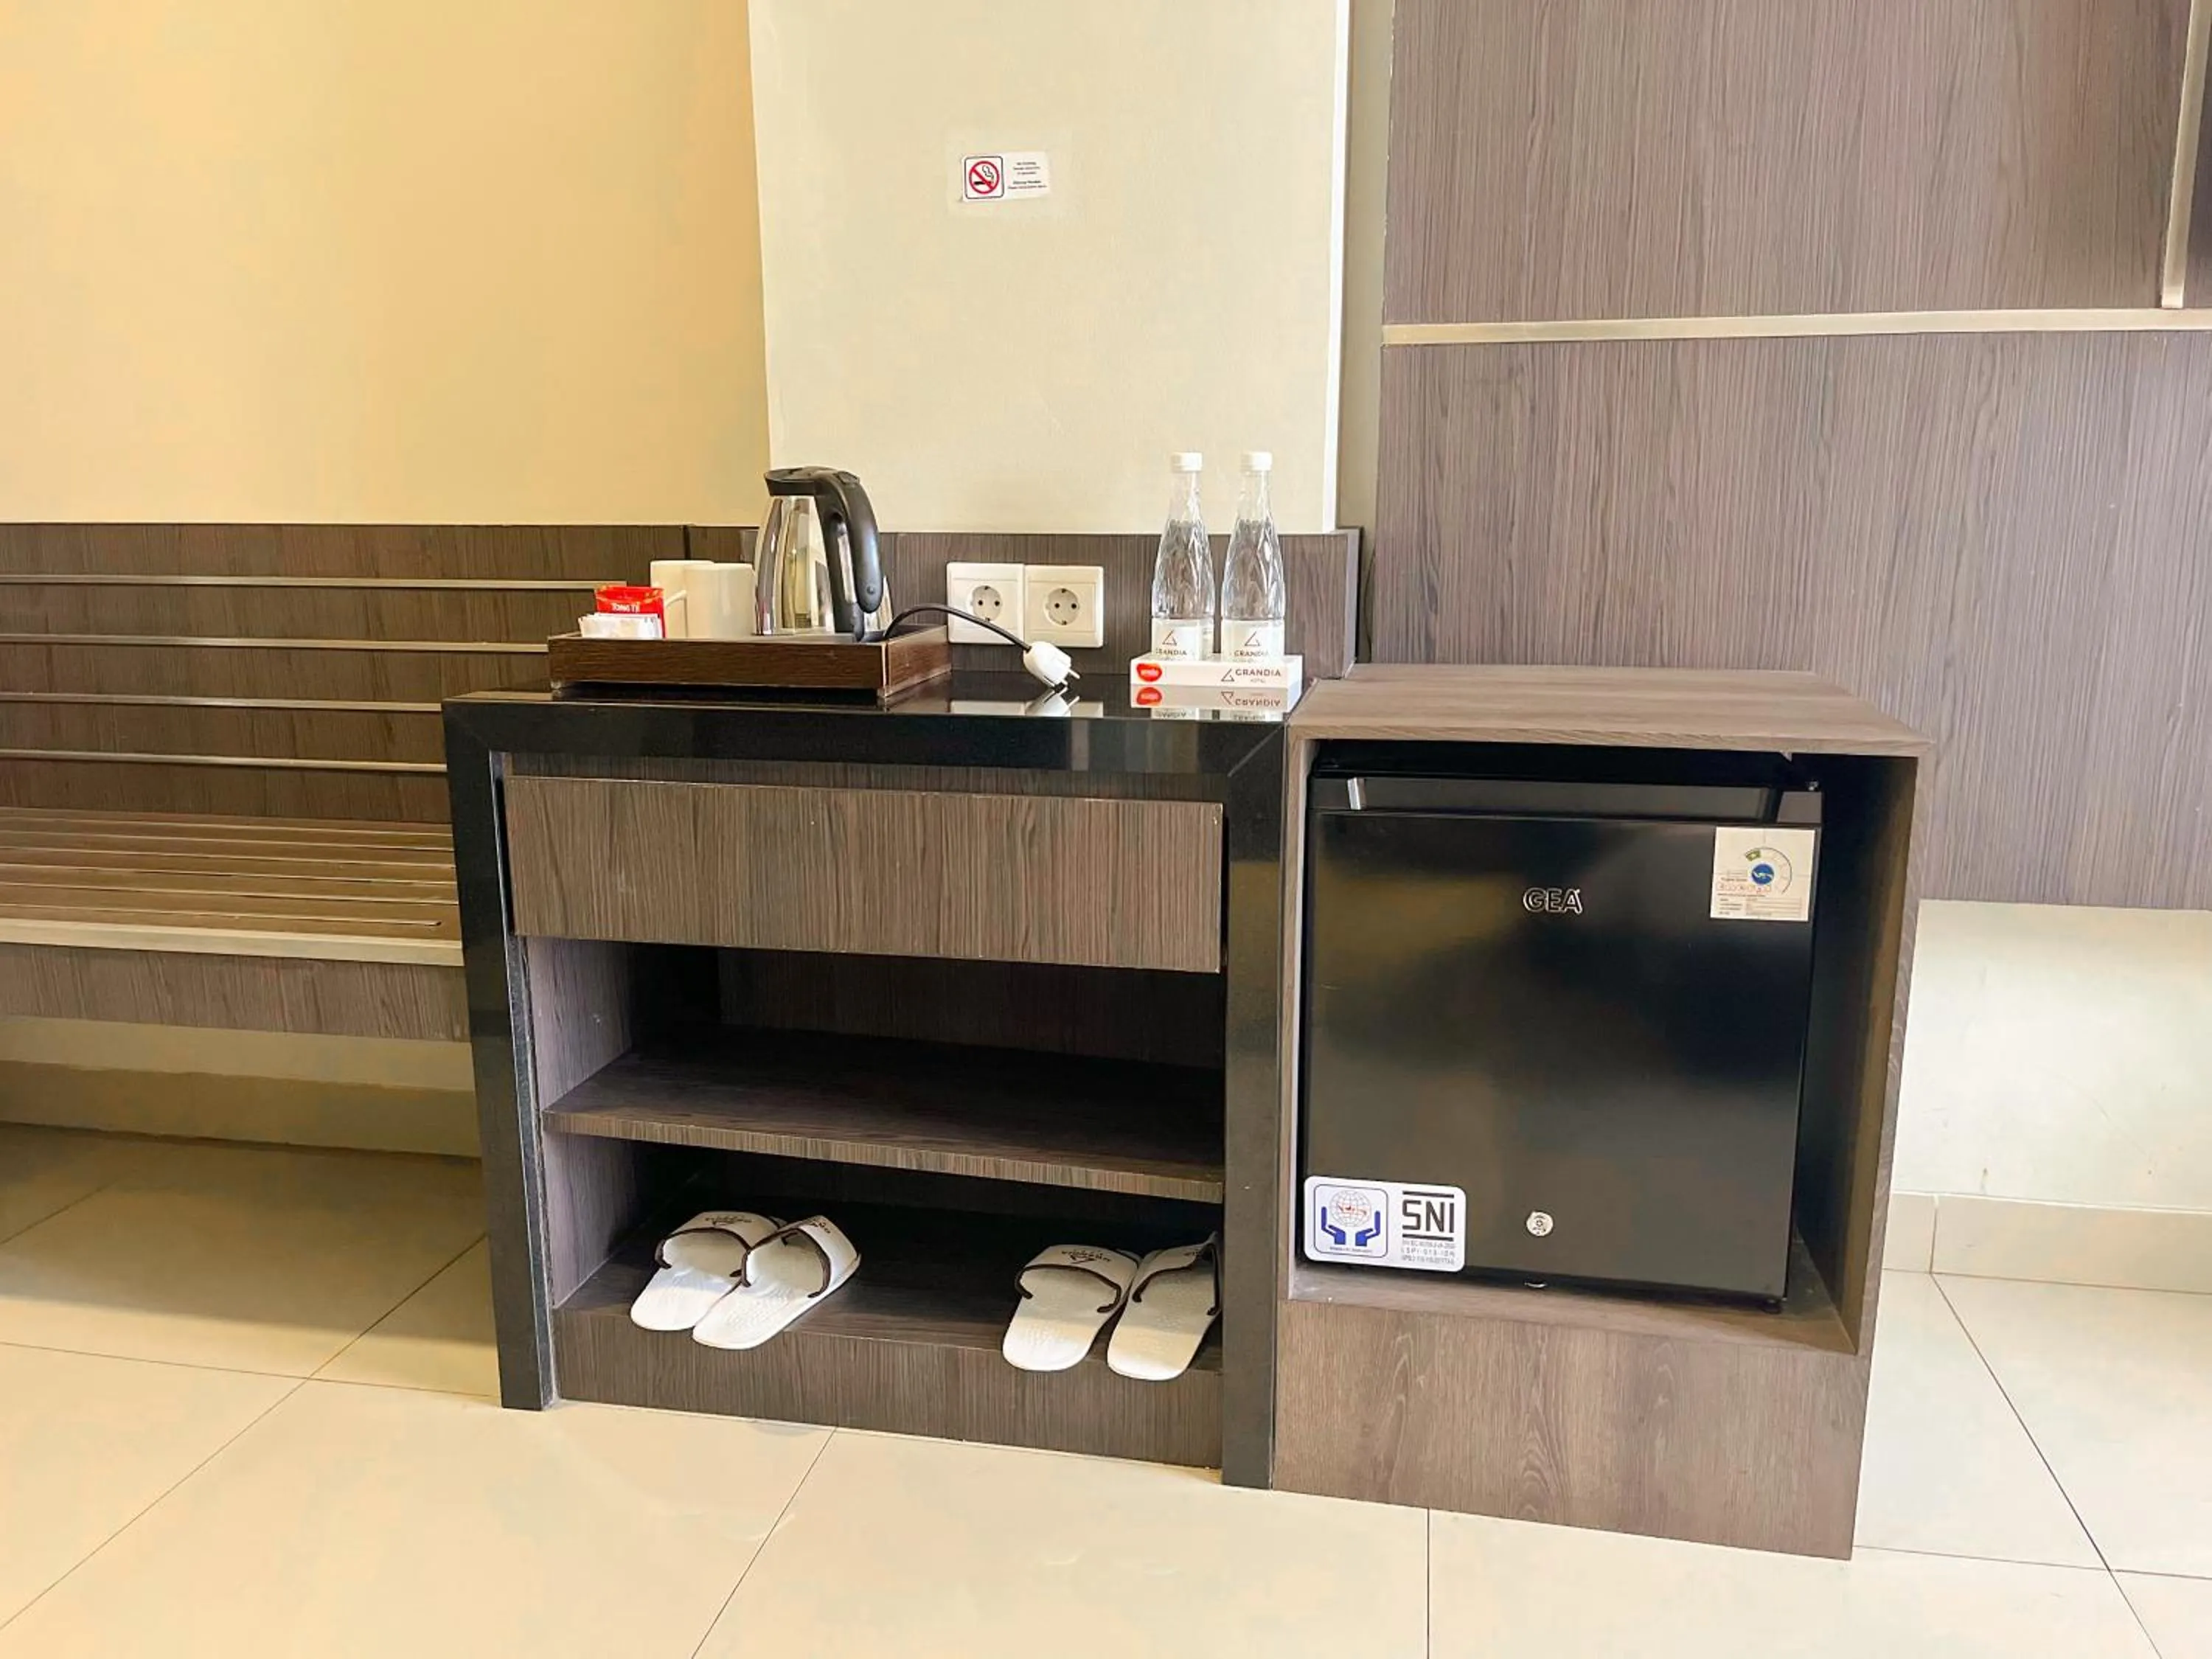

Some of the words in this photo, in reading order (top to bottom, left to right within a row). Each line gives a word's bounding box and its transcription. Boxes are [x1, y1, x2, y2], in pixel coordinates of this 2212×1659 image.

[1235, 668, 1281, 677] GRANDIA
[1523, 887, 1583, 914] GEA
[1402, 1200, 1454, 1234] SNI
